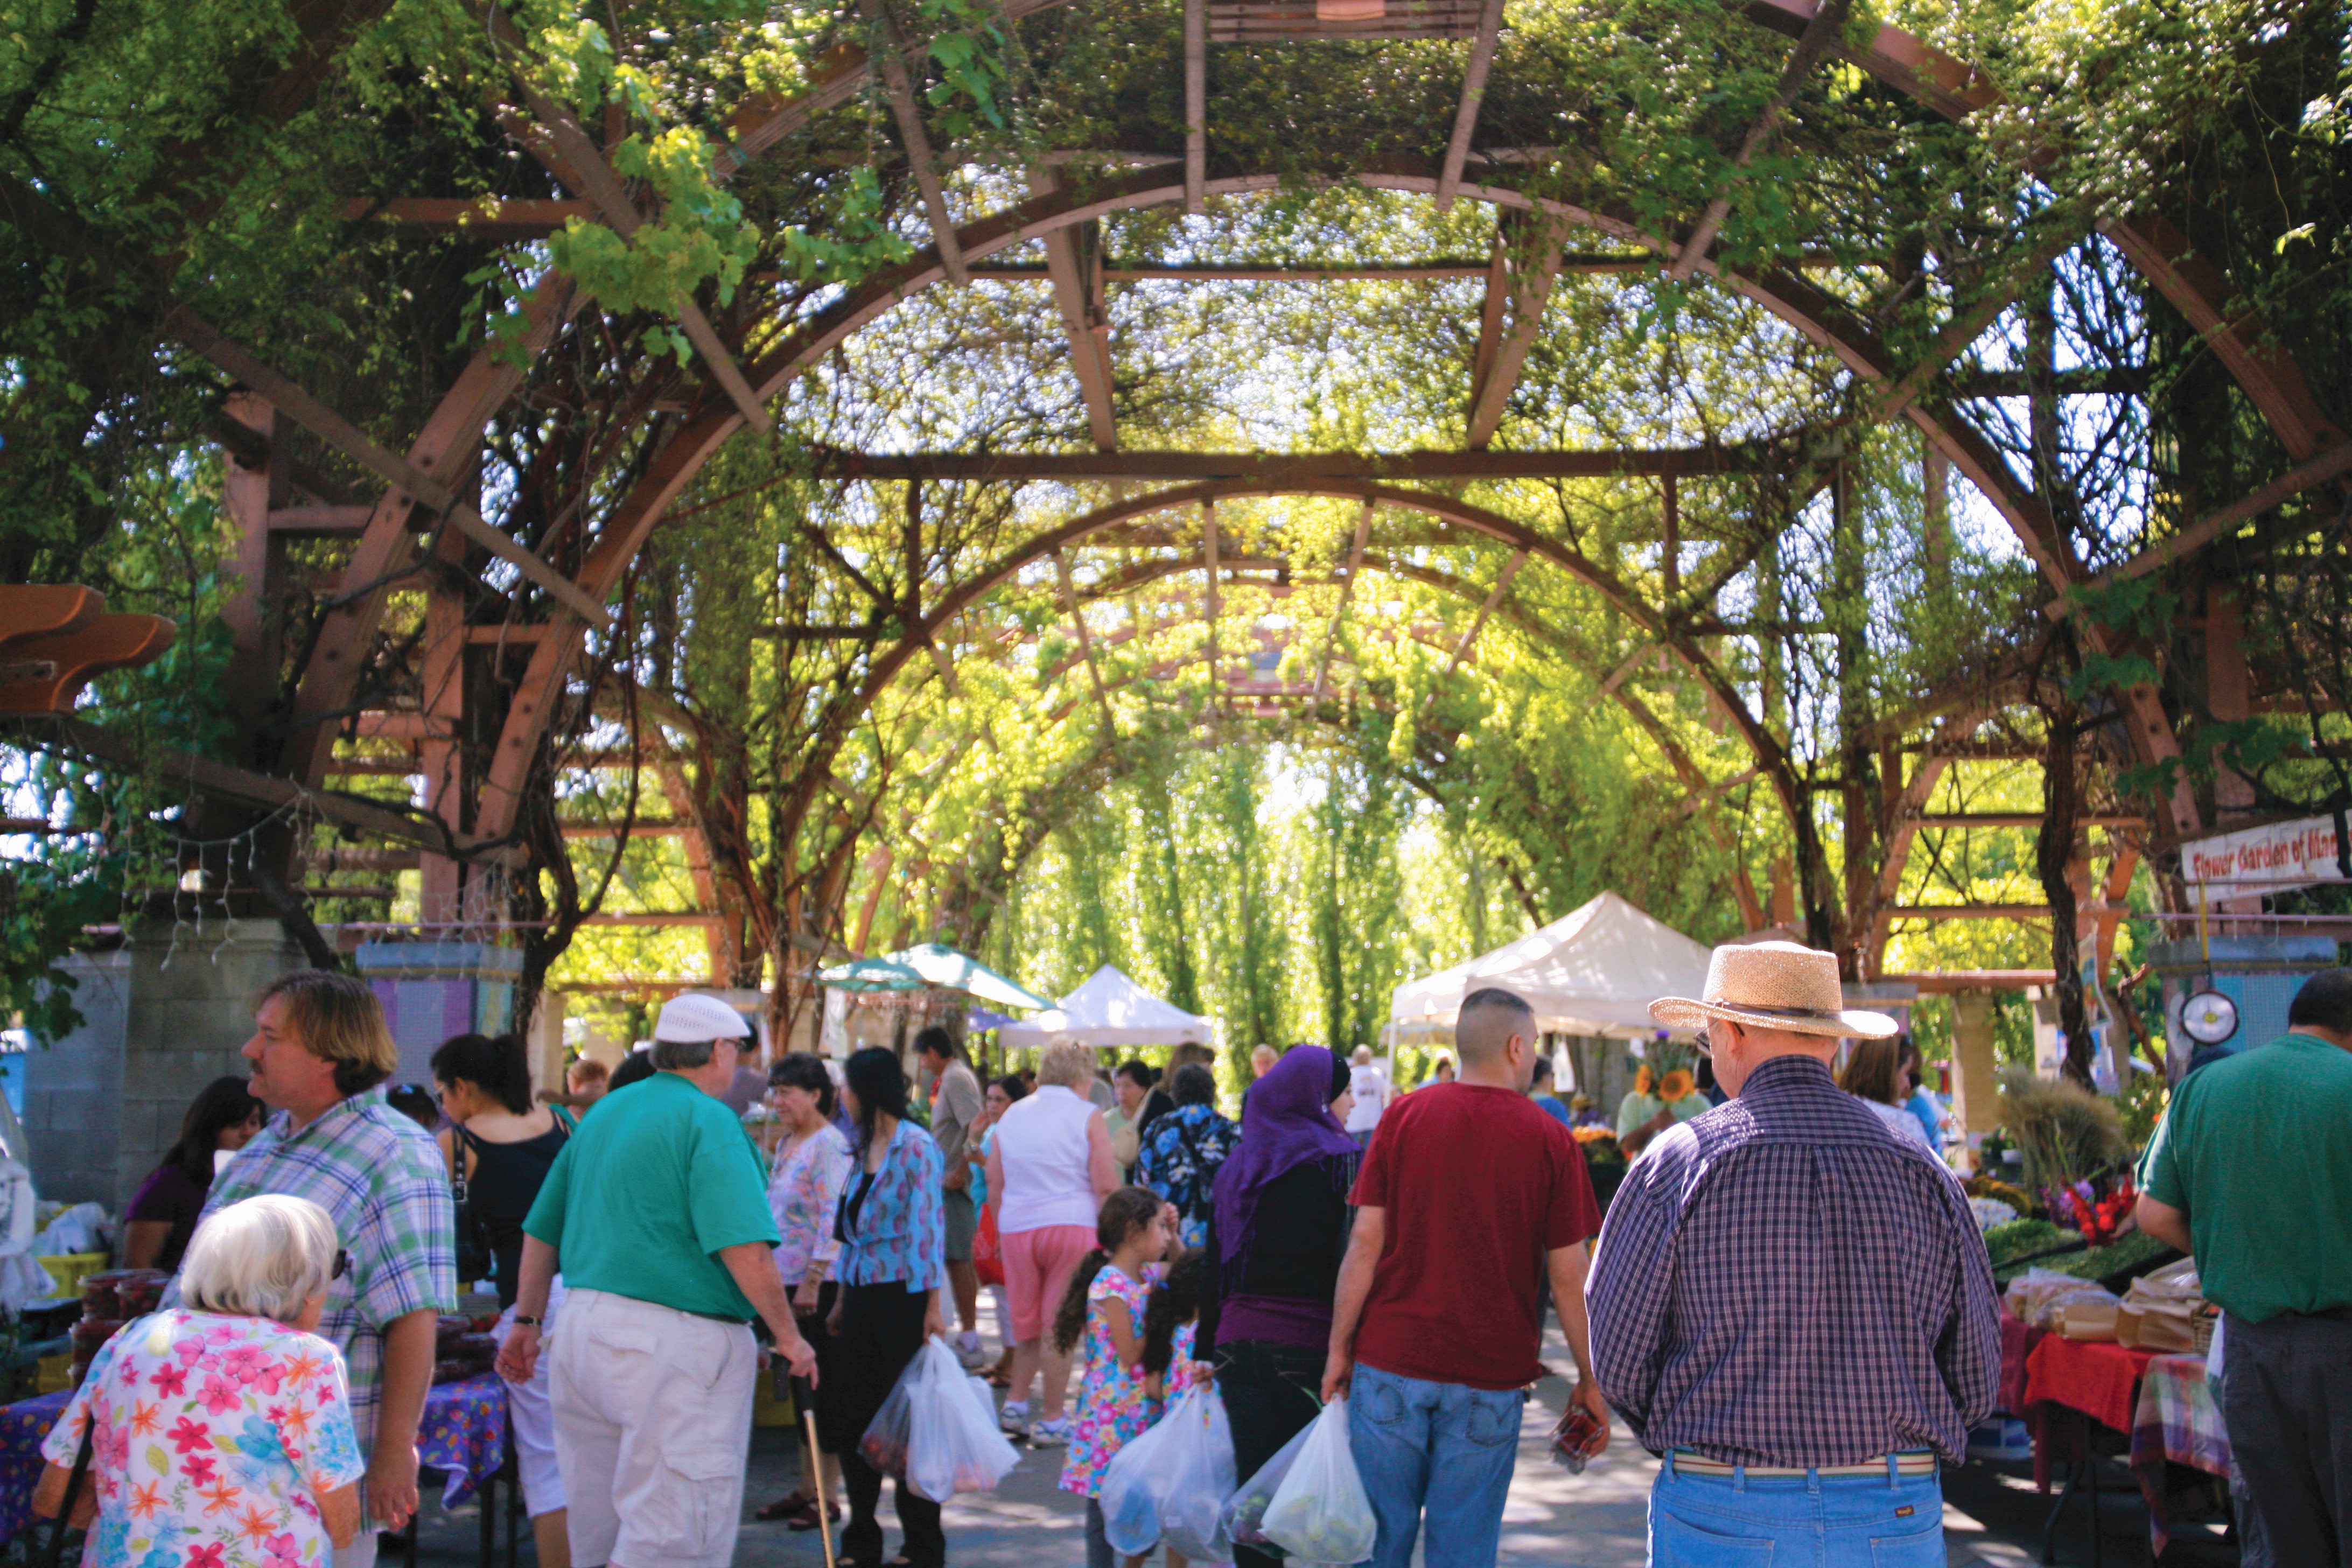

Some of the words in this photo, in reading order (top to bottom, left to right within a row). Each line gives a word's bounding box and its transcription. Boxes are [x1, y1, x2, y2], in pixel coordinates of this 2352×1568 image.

[2193, 852, 2235, 880] Flower
[2237, 836, 2288, 871] Garden
[2292, 830, 2307, 870] of
